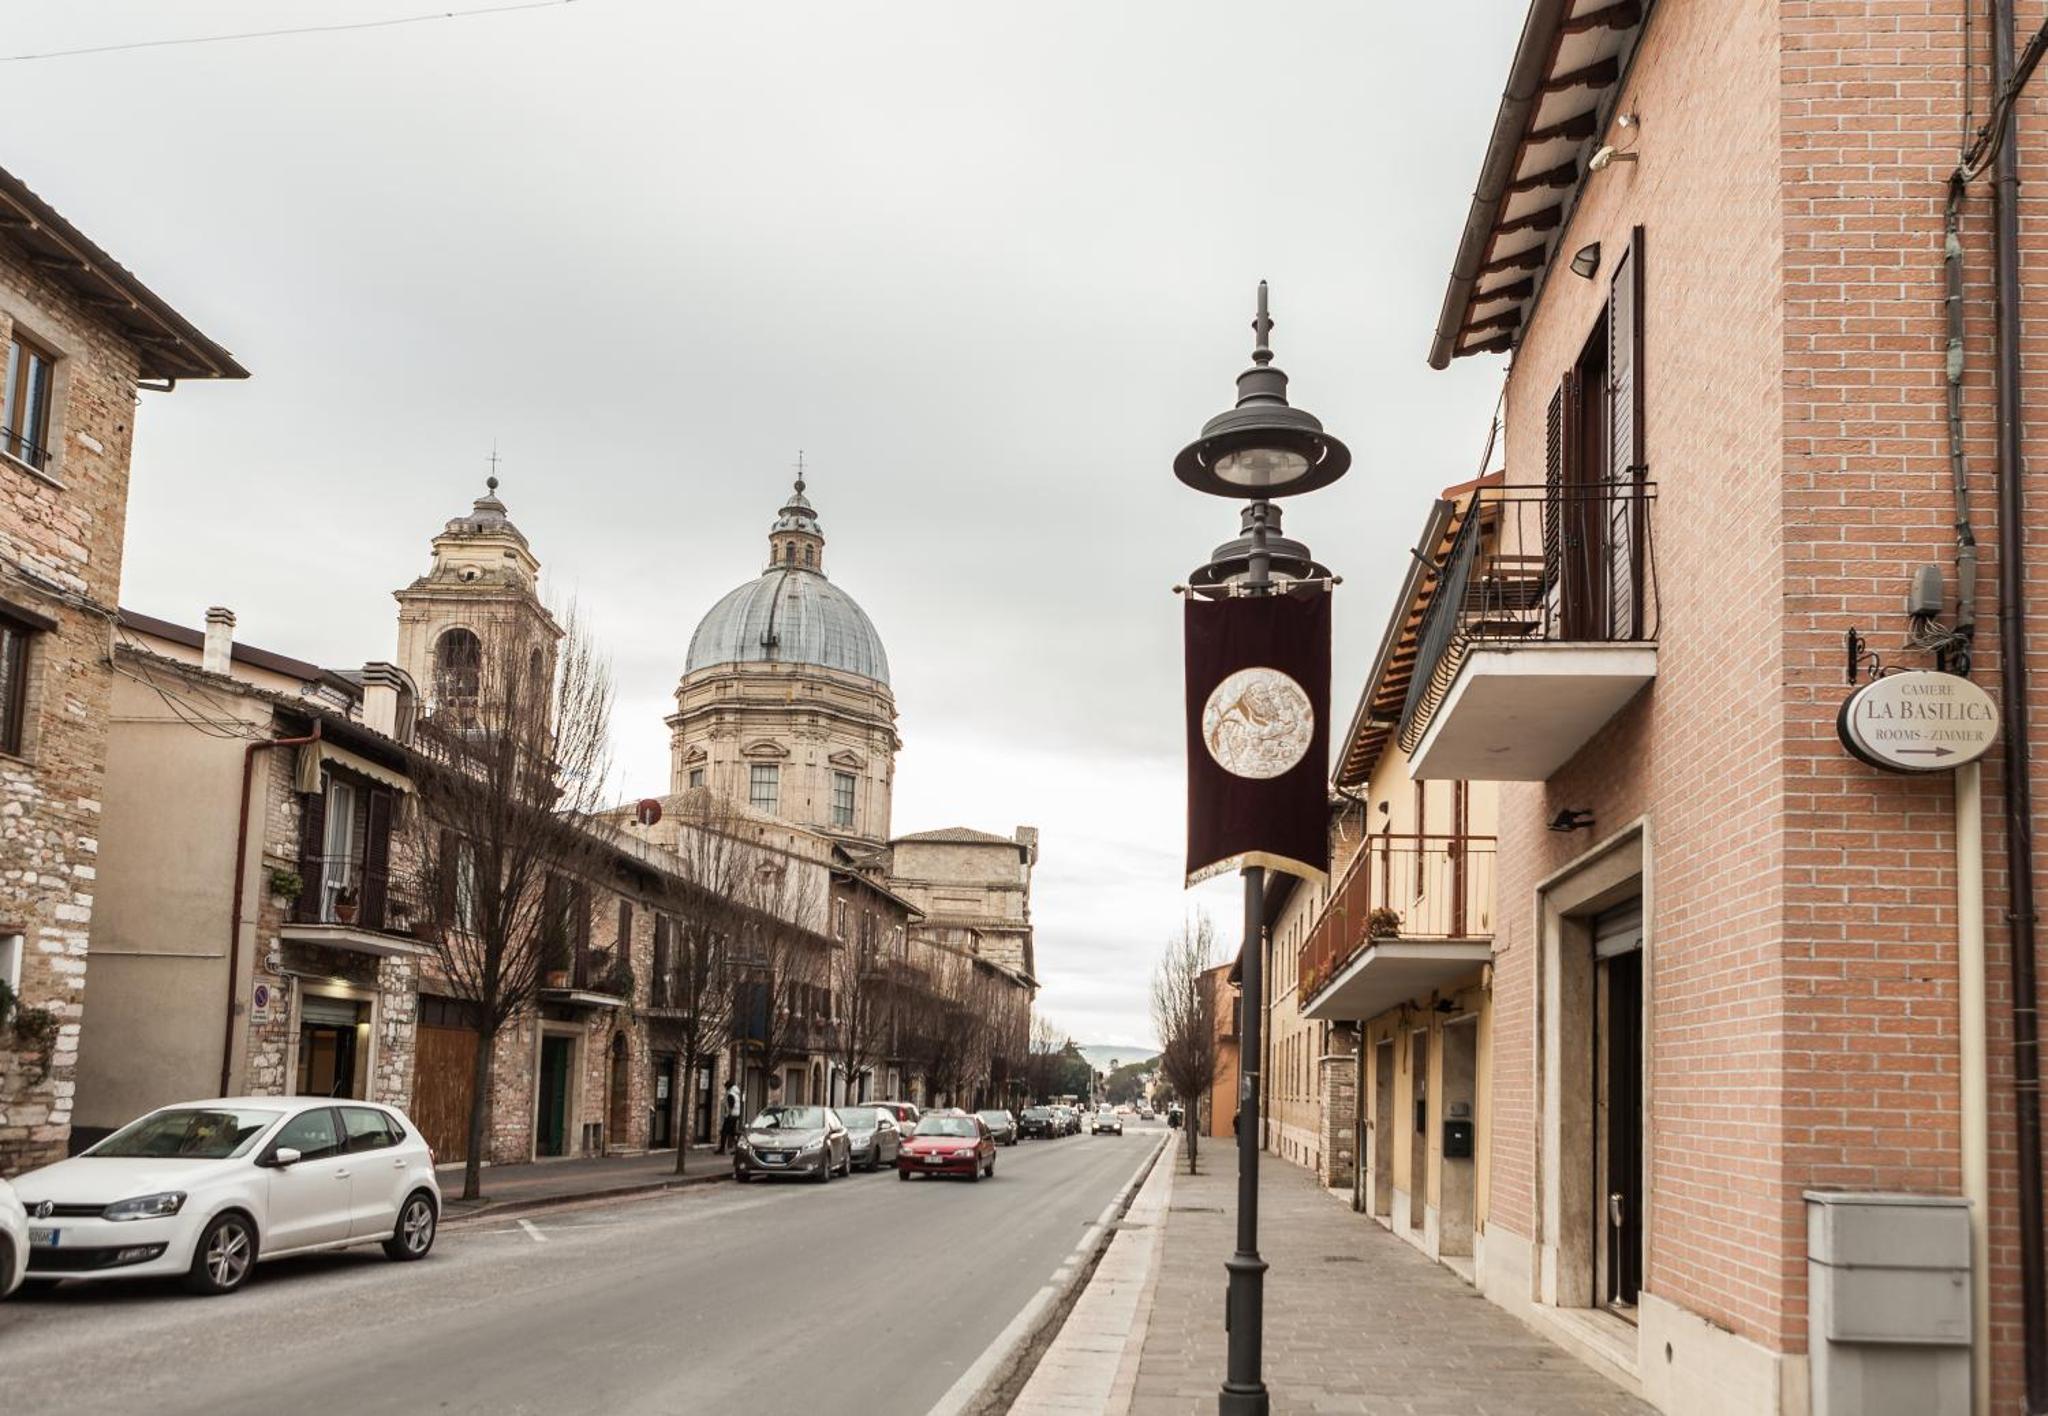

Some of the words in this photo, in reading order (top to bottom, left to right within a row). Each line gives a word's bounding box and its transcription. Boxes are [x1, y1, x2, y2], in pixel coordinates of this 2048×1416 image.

[1901, 684, 1955, 696] CAMERE
[1867, 700, 1893, 719] LA
[1900, 700, 1993, 721] BASILICA
